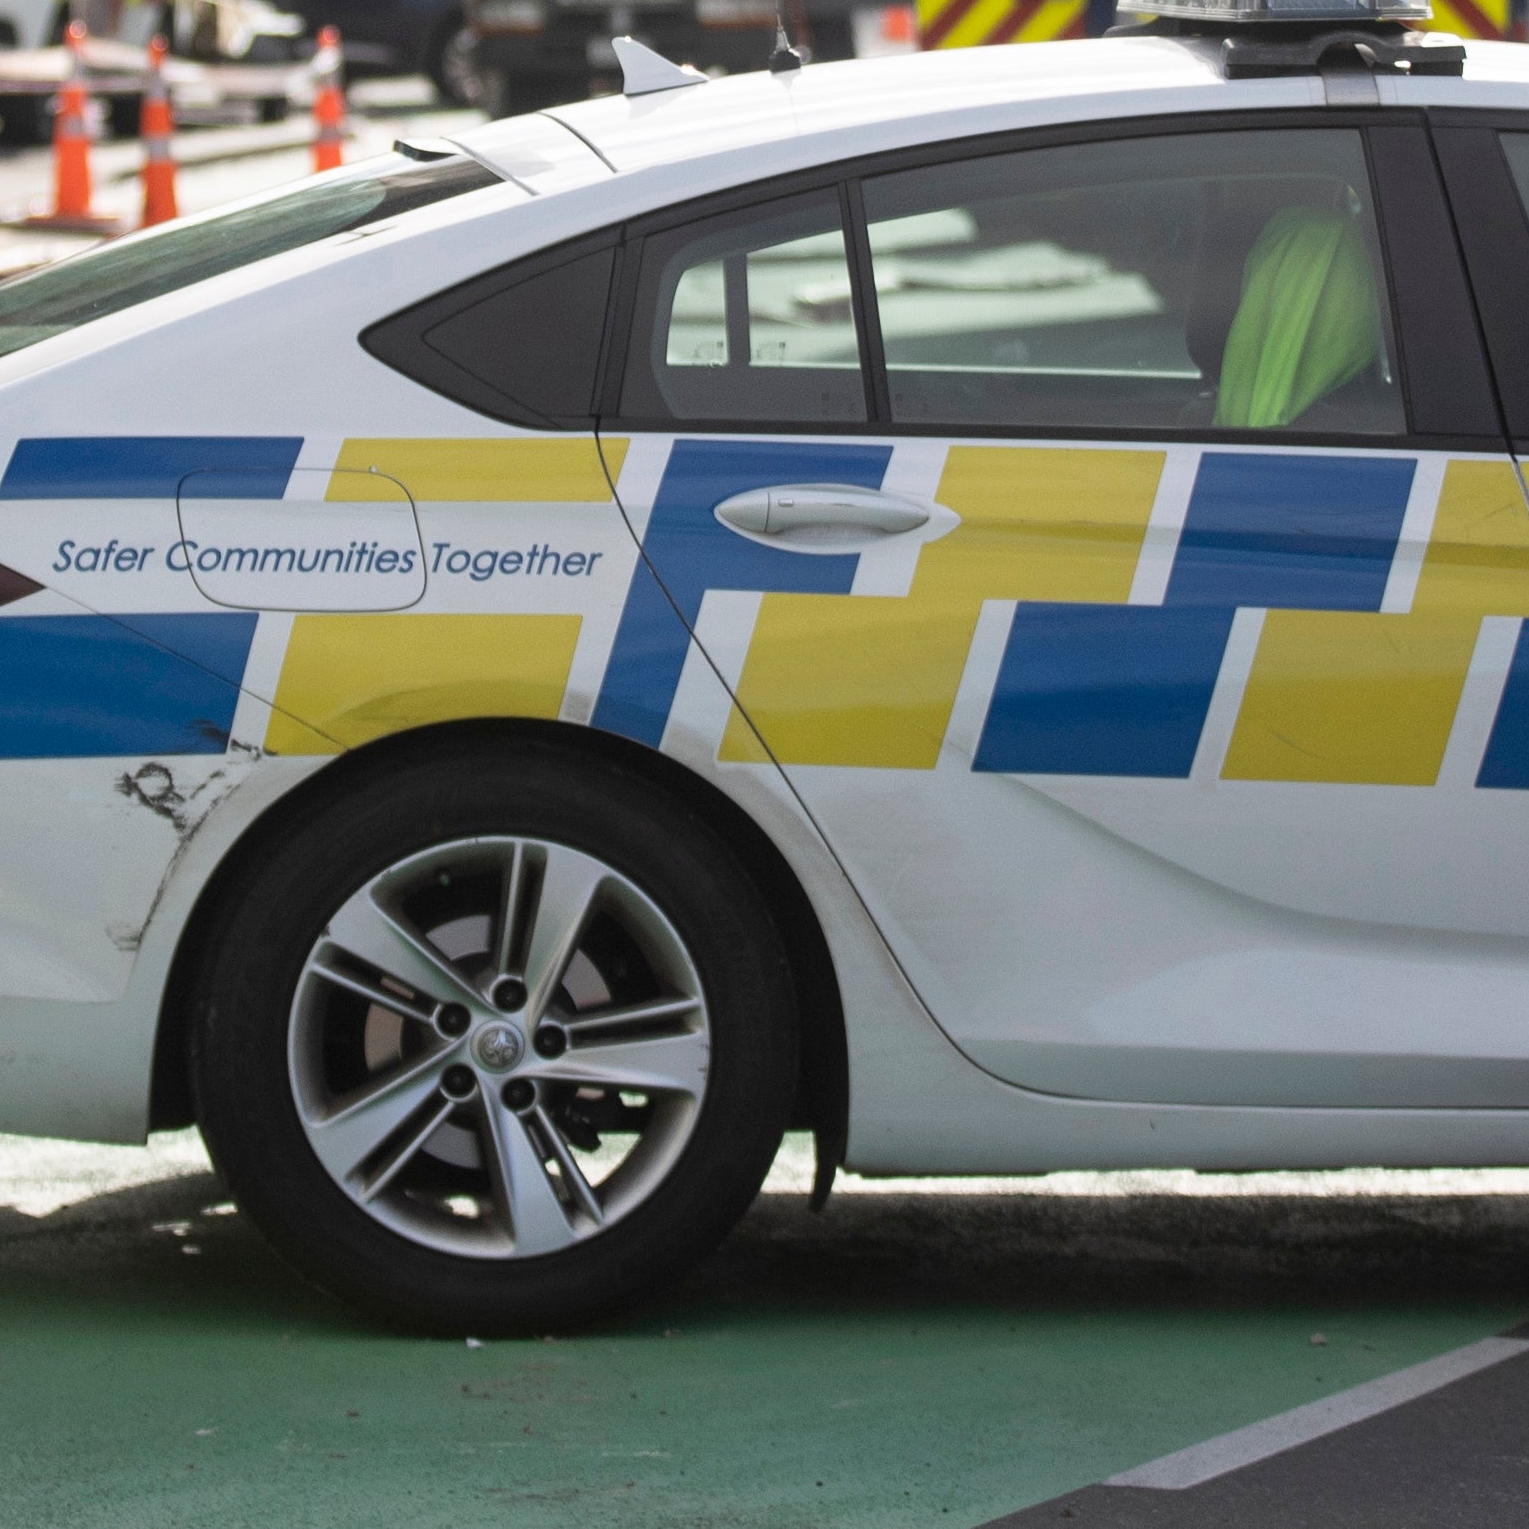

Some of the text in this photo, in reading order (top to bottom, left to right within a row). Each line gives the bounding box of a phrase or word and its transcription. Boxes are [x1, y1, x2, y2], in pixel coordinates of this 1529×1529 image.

[52, 540, 603, 582] Safer Communities Together
